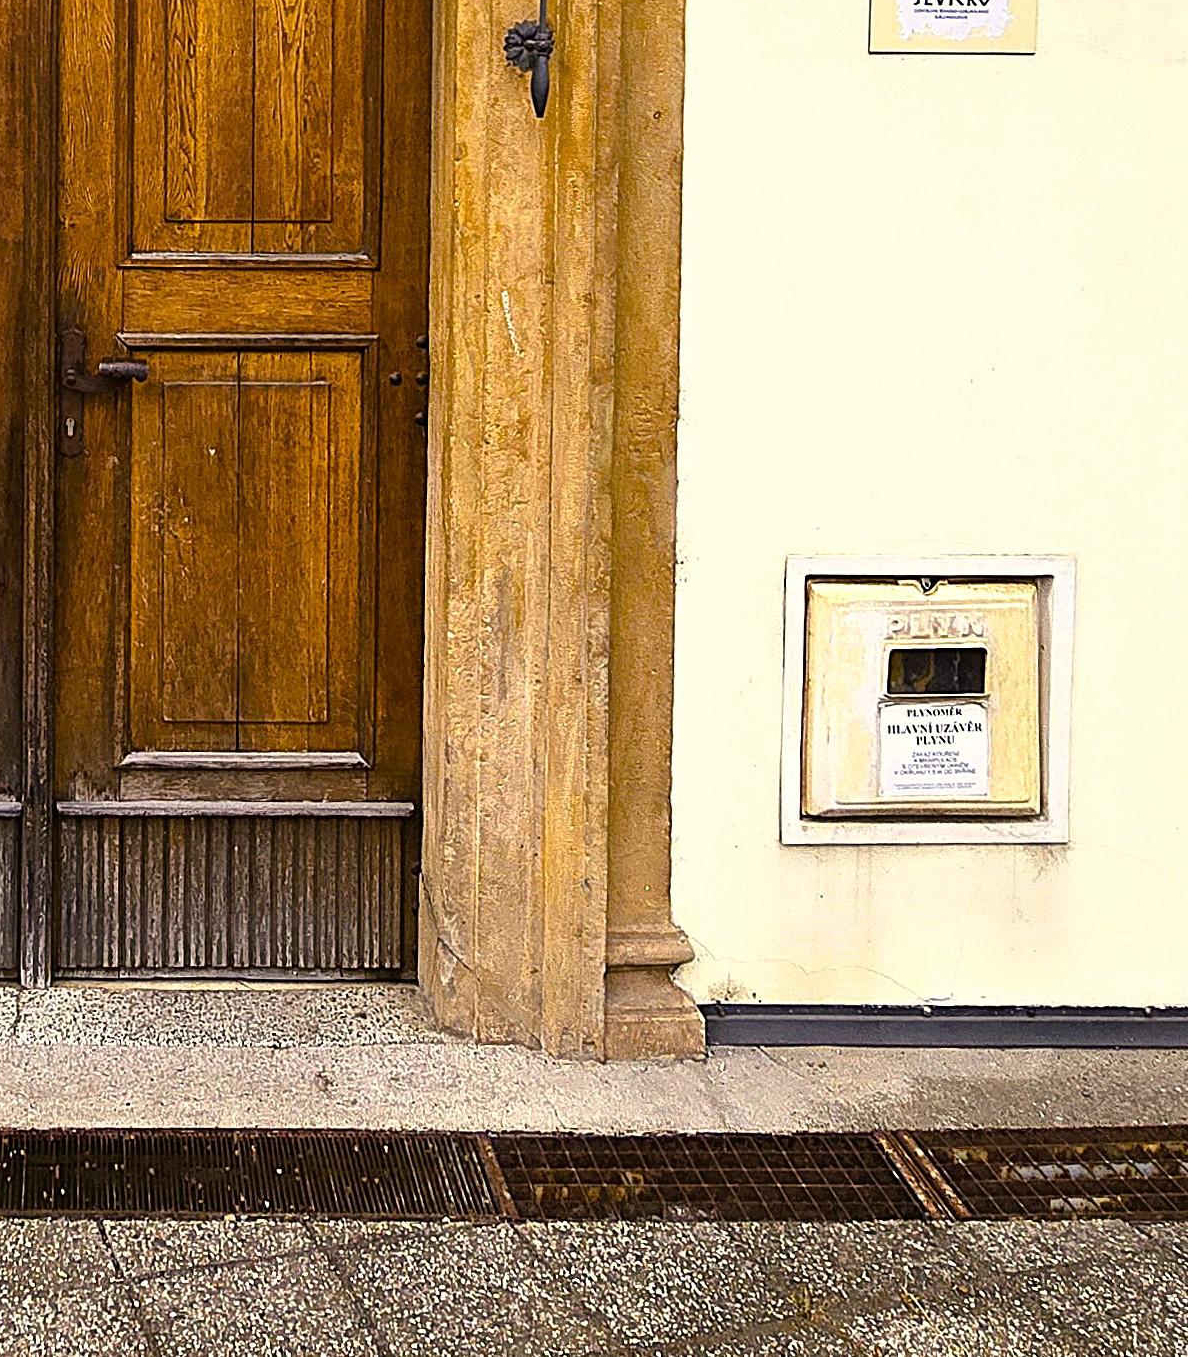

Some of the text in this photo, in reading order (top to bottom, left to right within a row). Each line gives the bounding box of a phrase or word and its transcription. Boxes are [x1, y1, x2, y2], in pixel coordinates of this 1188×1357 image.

[885, 611, 987, 640] PLYN
[906, 706, 963, 718] PLYNOMĚR
[887, 720, 983, 735] HLAVNÍ UZÁVĚR
[915, 735, 955, 746] PLYNU
